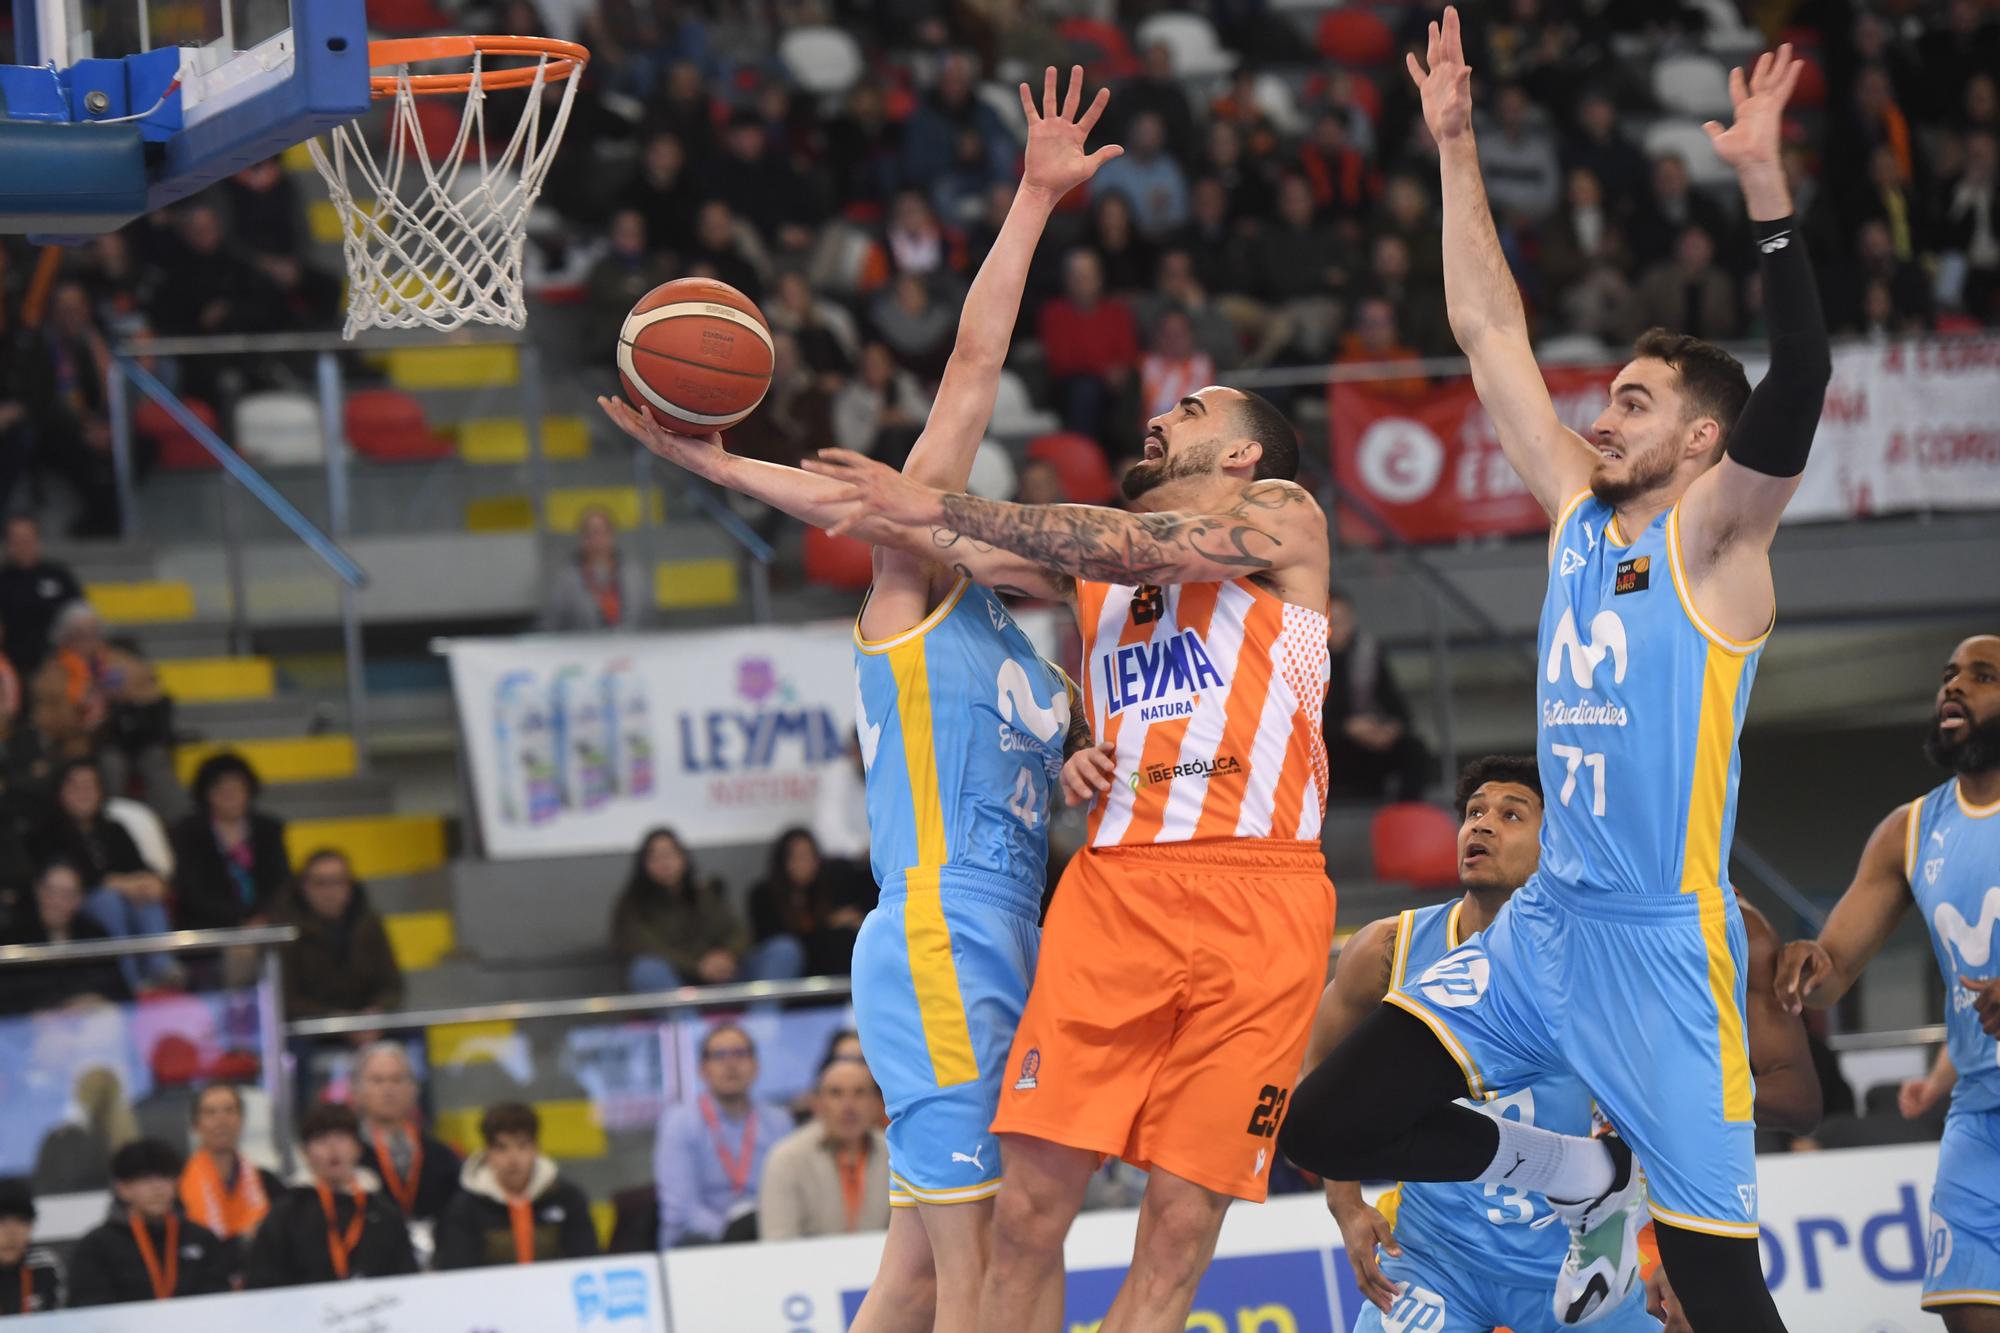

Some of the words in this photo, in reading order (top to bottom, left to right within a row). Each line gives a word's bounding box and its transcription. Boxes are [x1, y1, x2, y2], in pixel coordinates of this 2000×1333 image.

[1616, 582, 1635, 592] ORO
[1103, 631, 1224, 714] LEYMA
[1140, 699, 1193, 722] NATURA
[1543, 699, 1628, 727] Estudiantes
[676, 706, 843, 774] LEYMA
[1147, 756, 1240, 785] IBEREÓLICA
[1551, 742, 1606, 817] 71
